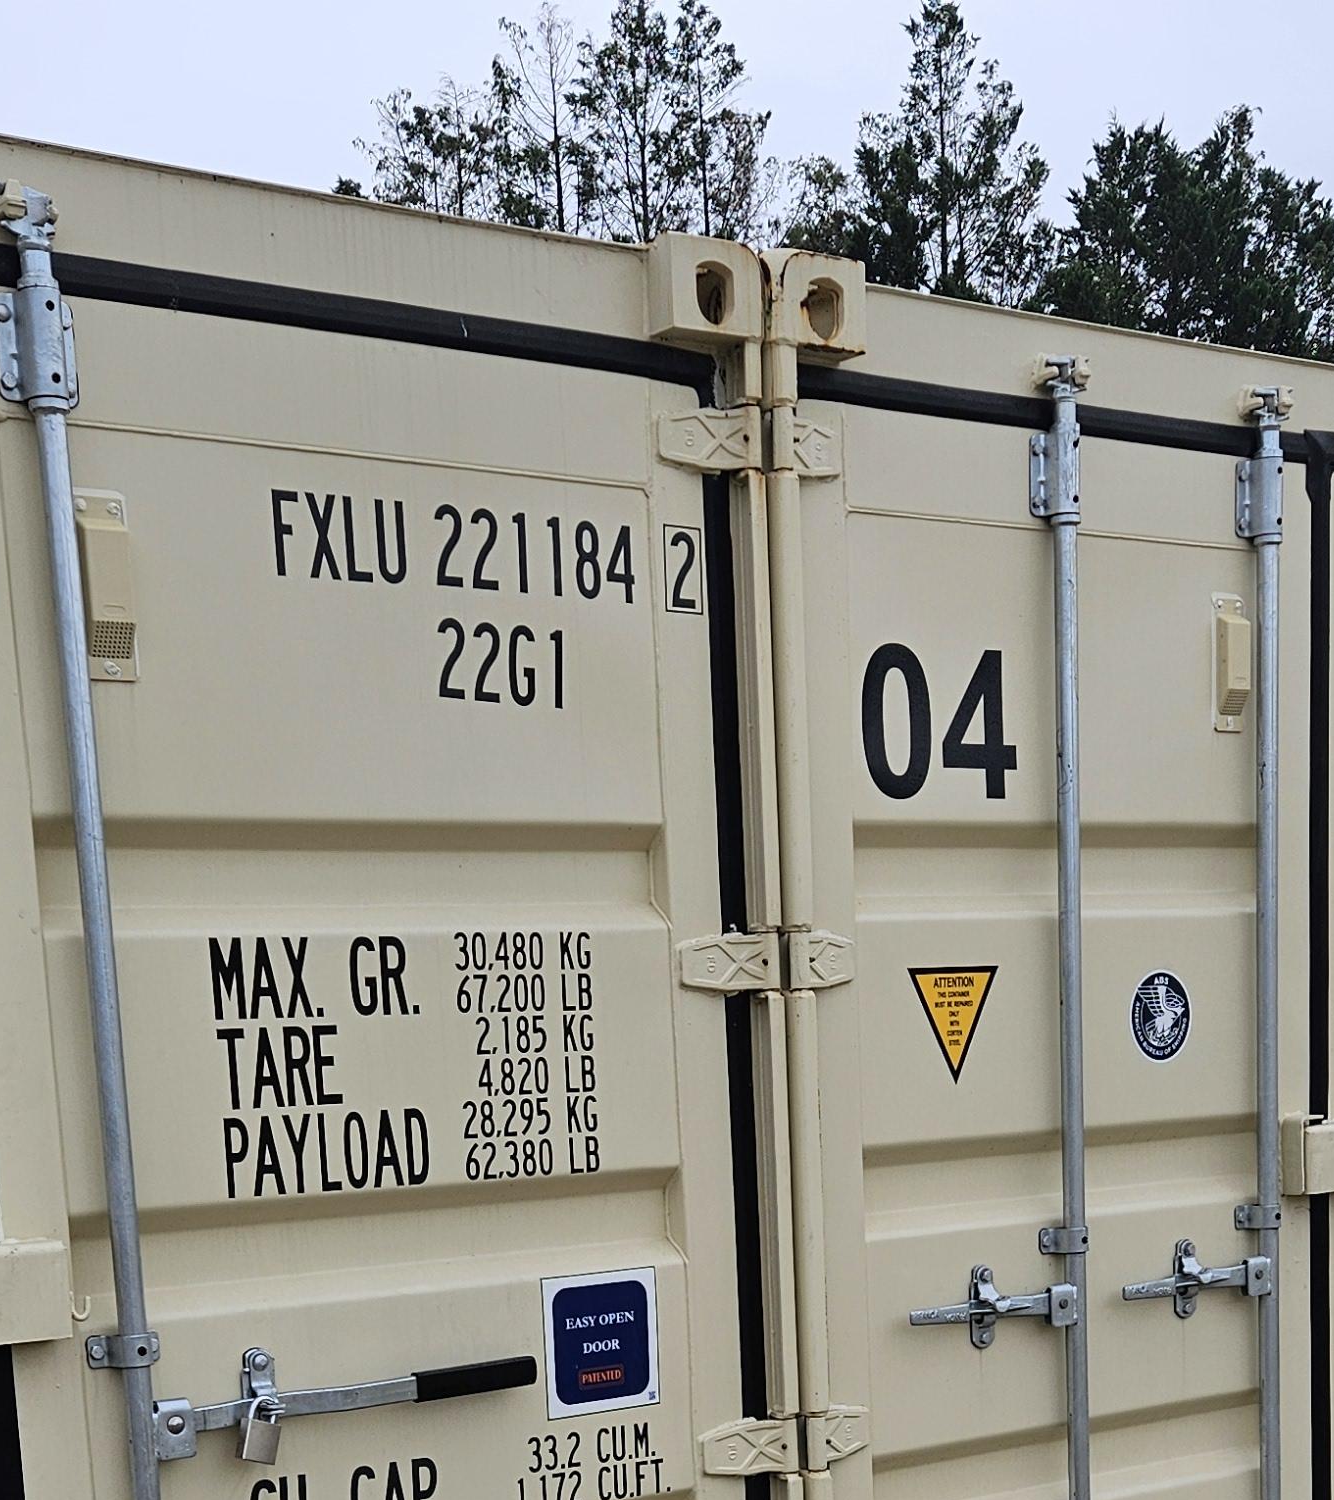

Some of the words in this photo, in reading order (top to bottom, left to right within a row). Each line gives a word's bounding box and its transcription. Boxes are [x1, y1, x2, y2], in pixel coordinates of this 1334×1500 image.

[271, 489, 406, 584] FXLU
[434, 504, 635, 604] 221184
[671, 532, 696, 609] 2
[438, 618, 563, 709] 22G1
[862, 643, 1017, 799] 04
[209, 937, 324, 1020] MAX.
[350, 936, 420, 1016] GR.
[454, 932, 543, 971] 30,480
[560, 932, 591, 970] KG
[457, 974, 545, 1013] 67,200
[561, 973, 592, 1011] LB
[934, 977, 974, 988] ATTENTION
[1154, 976, 1169, 985] ABS
[216, 1025, 343, 1110] TARE
[476, 1015, 547, 1055] 2,185
[563, 1014, 593, 1052] KG
[479, 1057, 549, 1096] 4,820
[565, 1055, 595, 1093] LB
[222, 1108, 430, 1199] PAYLOAD
[463, 1097, 550, 1139] 28,295
[567, 1095, 597, 1133] KG
[466, 1138, 553, 1180] 62,380
[569, 1136, 599, 1174] LB
[566, 1315, 597, 1330] EASY
[599, 1310, 635, 1325] OPEN
[583, 1339, 620, 1354] DOOR
[581, 1369, 622, 1384] PATENTED
[528, 1431, 581, 1473] 33.2
[597, 1422, 655, 1463] CU.M.
